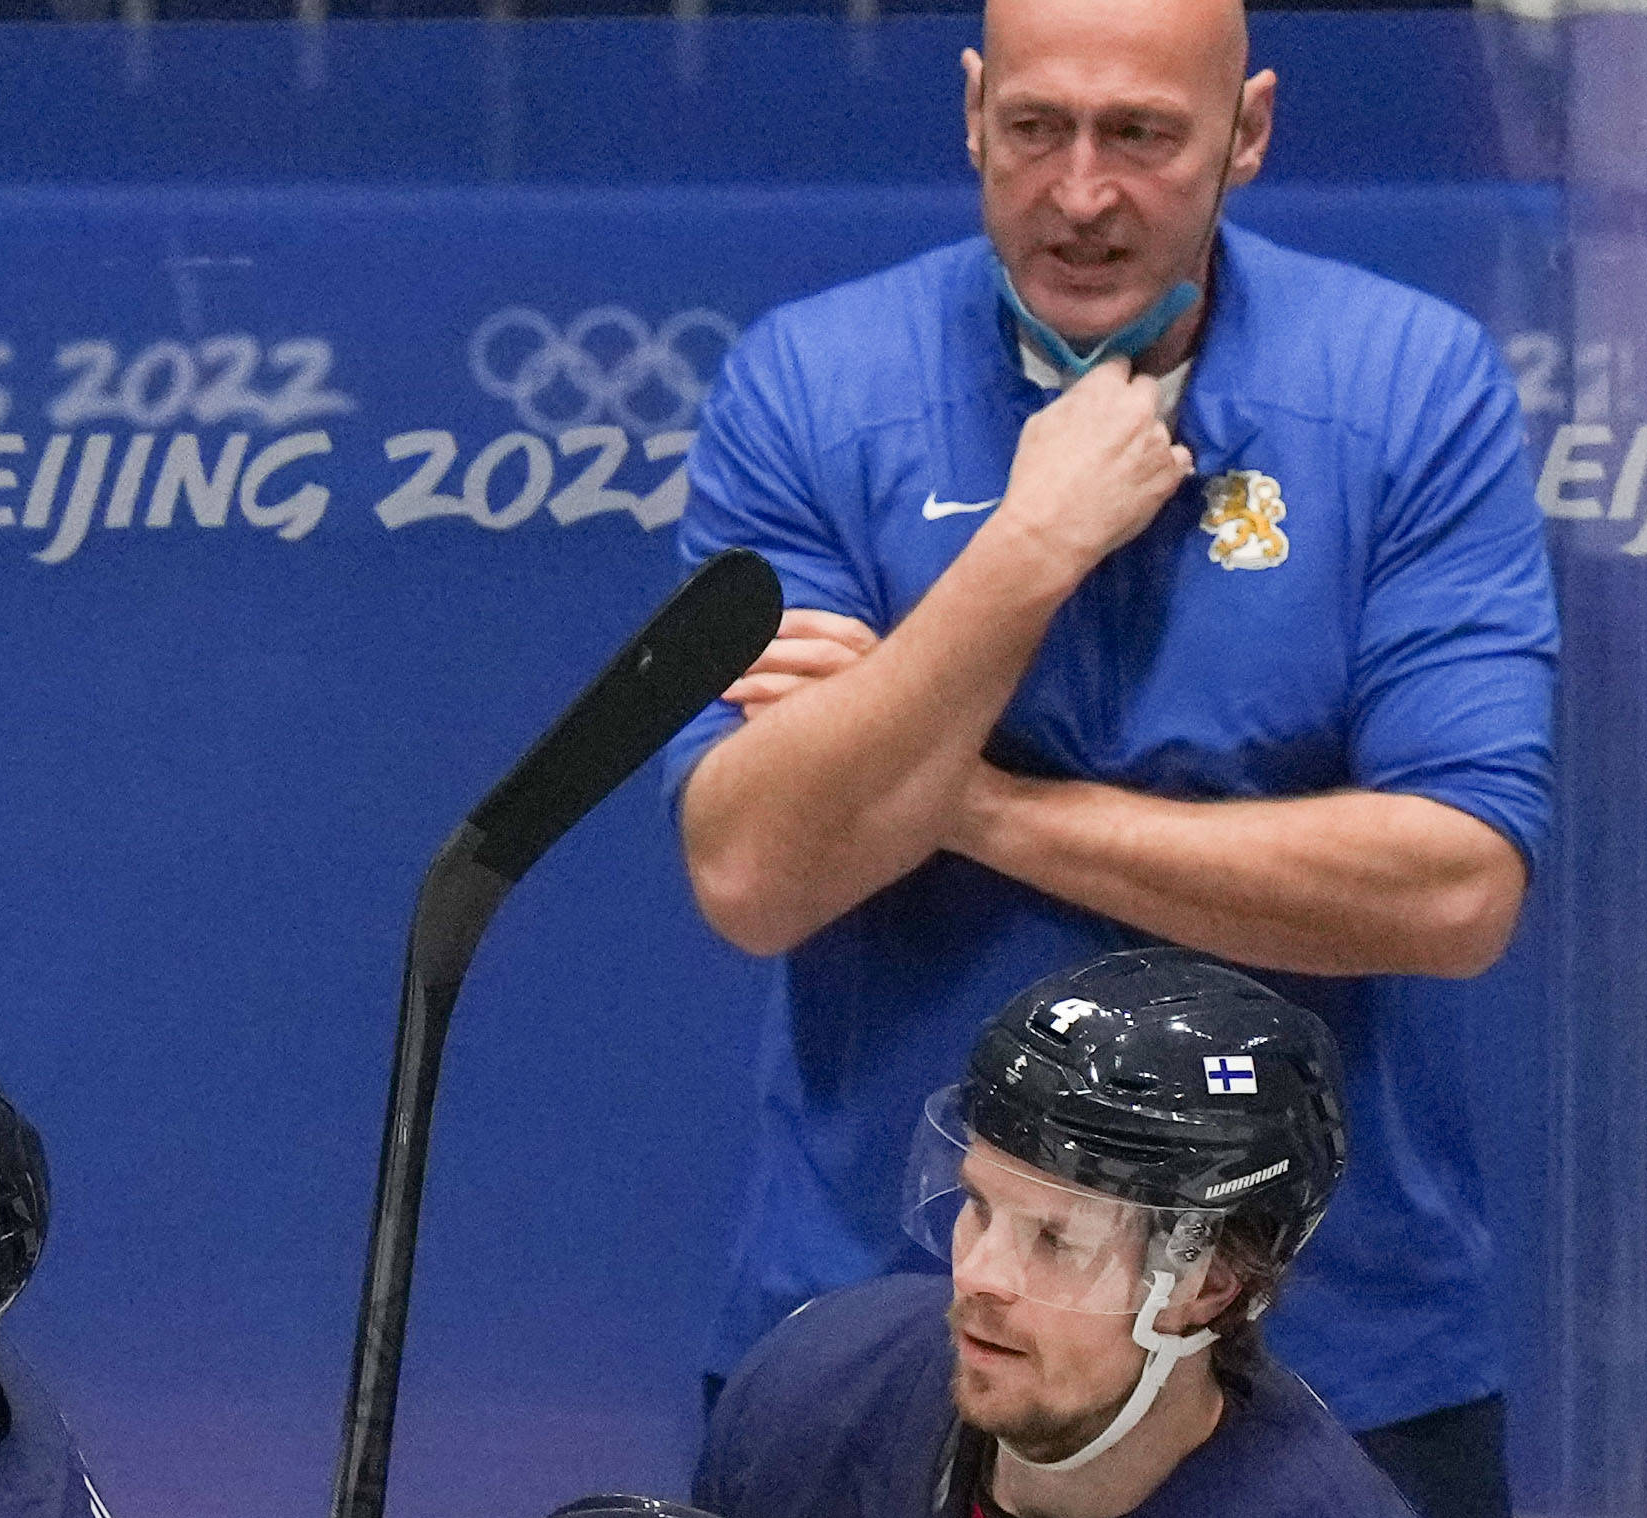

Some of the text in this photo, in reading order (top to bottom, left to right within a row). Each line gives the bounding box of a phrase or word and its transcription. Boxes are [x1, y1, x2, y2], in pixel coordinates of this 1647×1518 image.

[55, 335, 348, 430] 2022
[1049, 997, 1092, 1034] 4
[1204, 1158, 1290, 1200] WARRIOR
